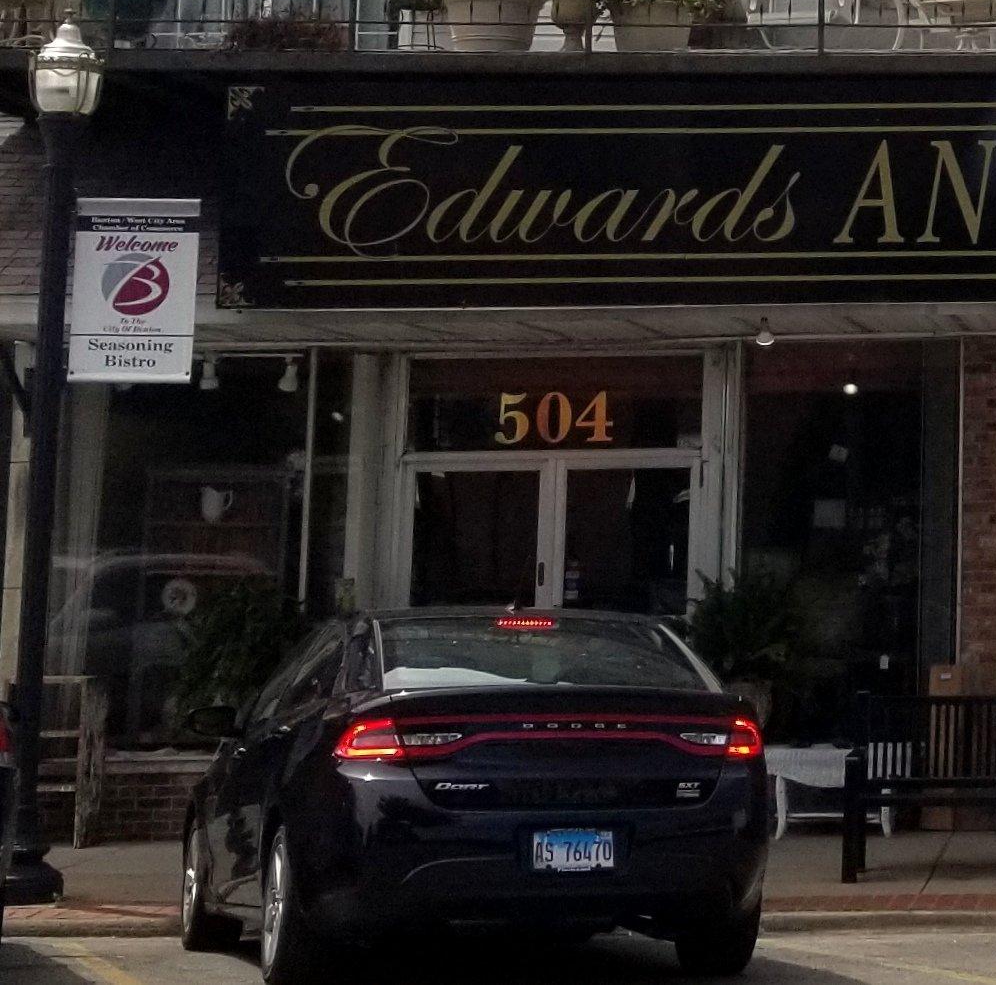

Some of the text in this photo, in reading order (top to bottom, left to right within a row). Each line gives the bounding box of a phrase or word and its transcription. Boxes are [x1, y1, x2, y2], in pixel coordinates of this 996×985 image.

[96, 234, 179, 252] Welcome
[88, 337, 175, 354] Seasoning
[105, 355, 157, 368] Bistro
[494, 390, 614, 445] 504
[522, 721, 628, 730] DODGE
[678, 781, 701, 789] SXT
[536, 840, 612, 863] AS 76470
